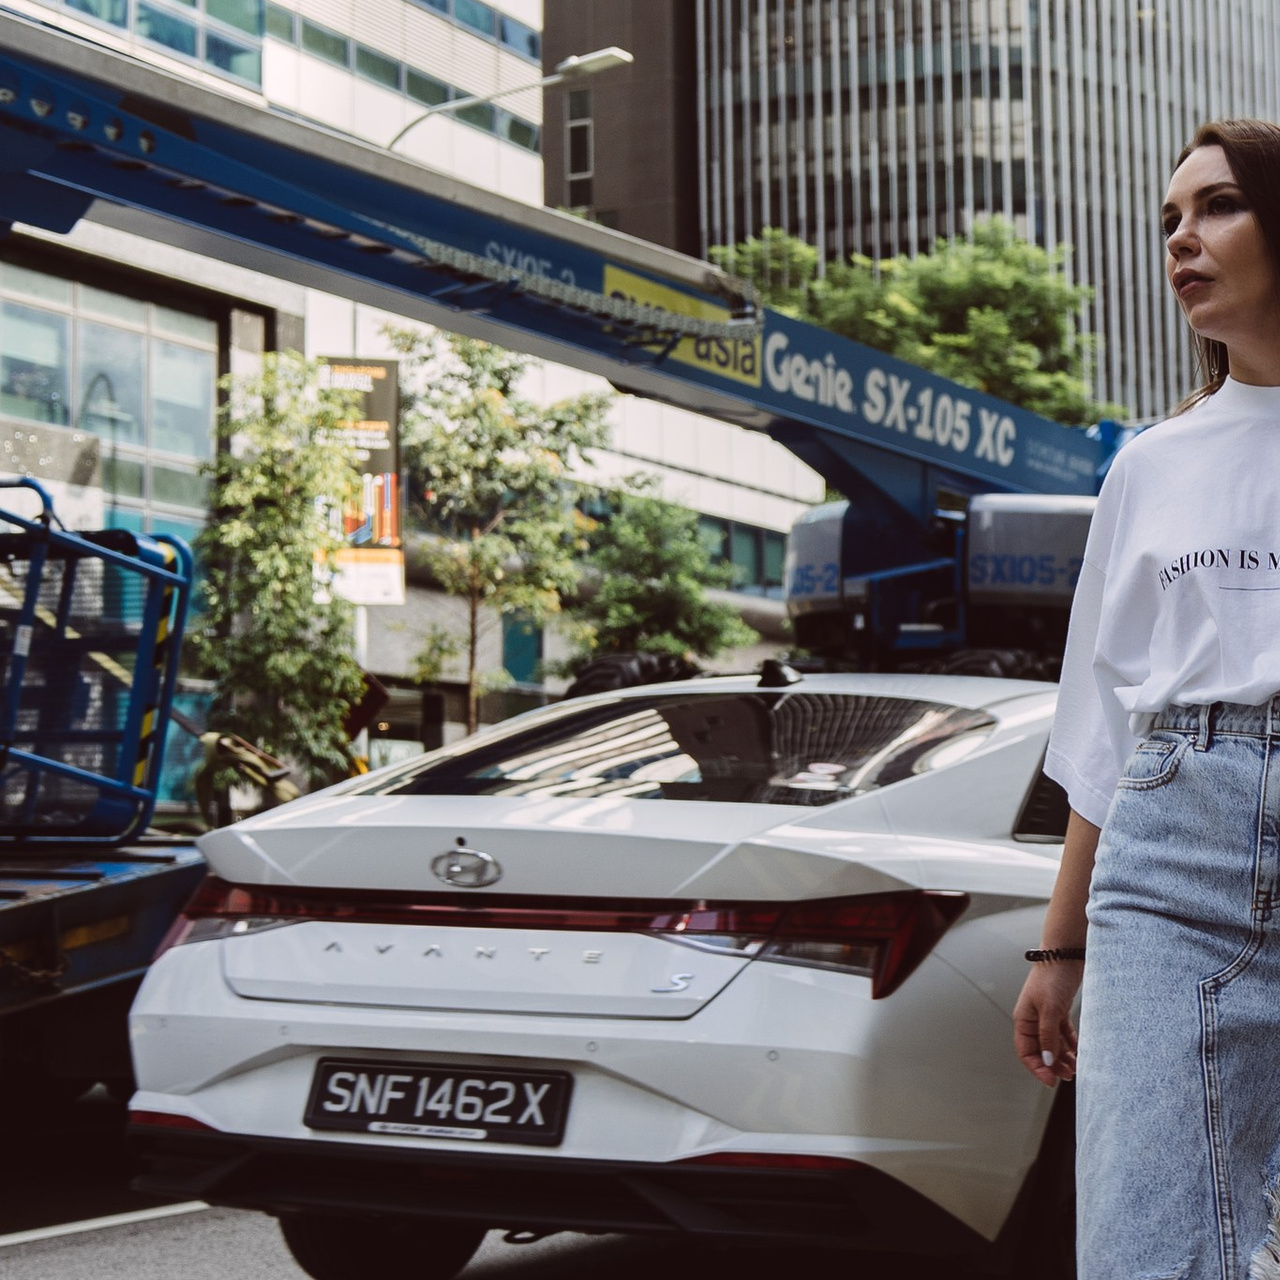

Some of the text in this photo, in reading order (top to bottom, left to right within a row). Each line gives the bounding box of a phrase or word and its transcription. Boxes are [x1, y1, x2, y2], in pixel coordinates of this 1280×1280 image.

[765, 331, 856, 414] Genie
[862, 368, 972, 452] SX-105
[974, 407, 1017, 467] XC
[1157, 548, 1231, 592] FASHION
[1238, 549, 1260, 570] IS
[324, 940, 604, 964] AVANTE
[322, 1071, 552, 1126] SNF1462X
